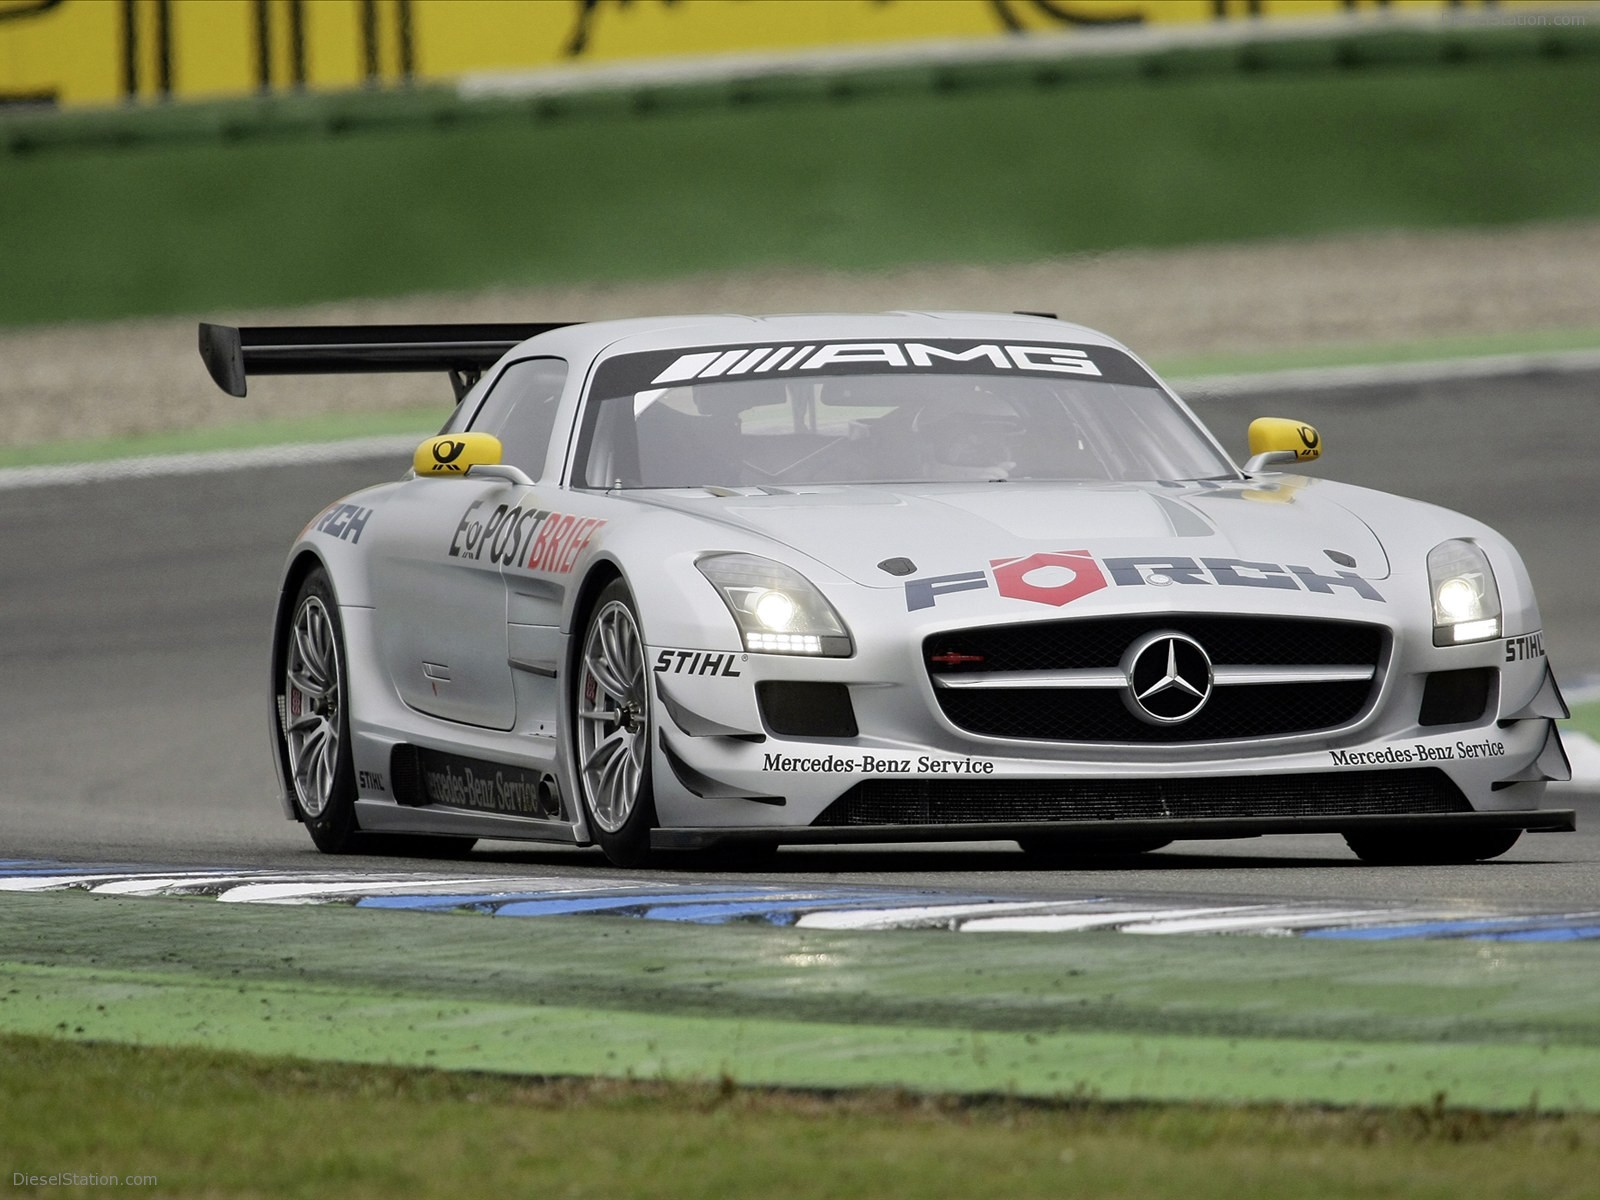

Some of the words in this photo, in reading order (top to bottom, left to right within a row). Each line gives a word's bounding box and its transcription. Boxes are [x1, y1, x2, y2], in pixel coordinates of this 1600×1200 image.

[799, 343, 1103, 376] AMG
[1505, 633, 1546, 662] STIHL
[762, 753, 911, 773] Mercedes-Benz
[917, 756, 995, 774] Service
[1329, 744, 1455, 766] Mercedes-Benz
[1456, 739, 1505, 760] Service
[359, 770, 385, 791] STIHL
[495, 770, 539, 813] Service
